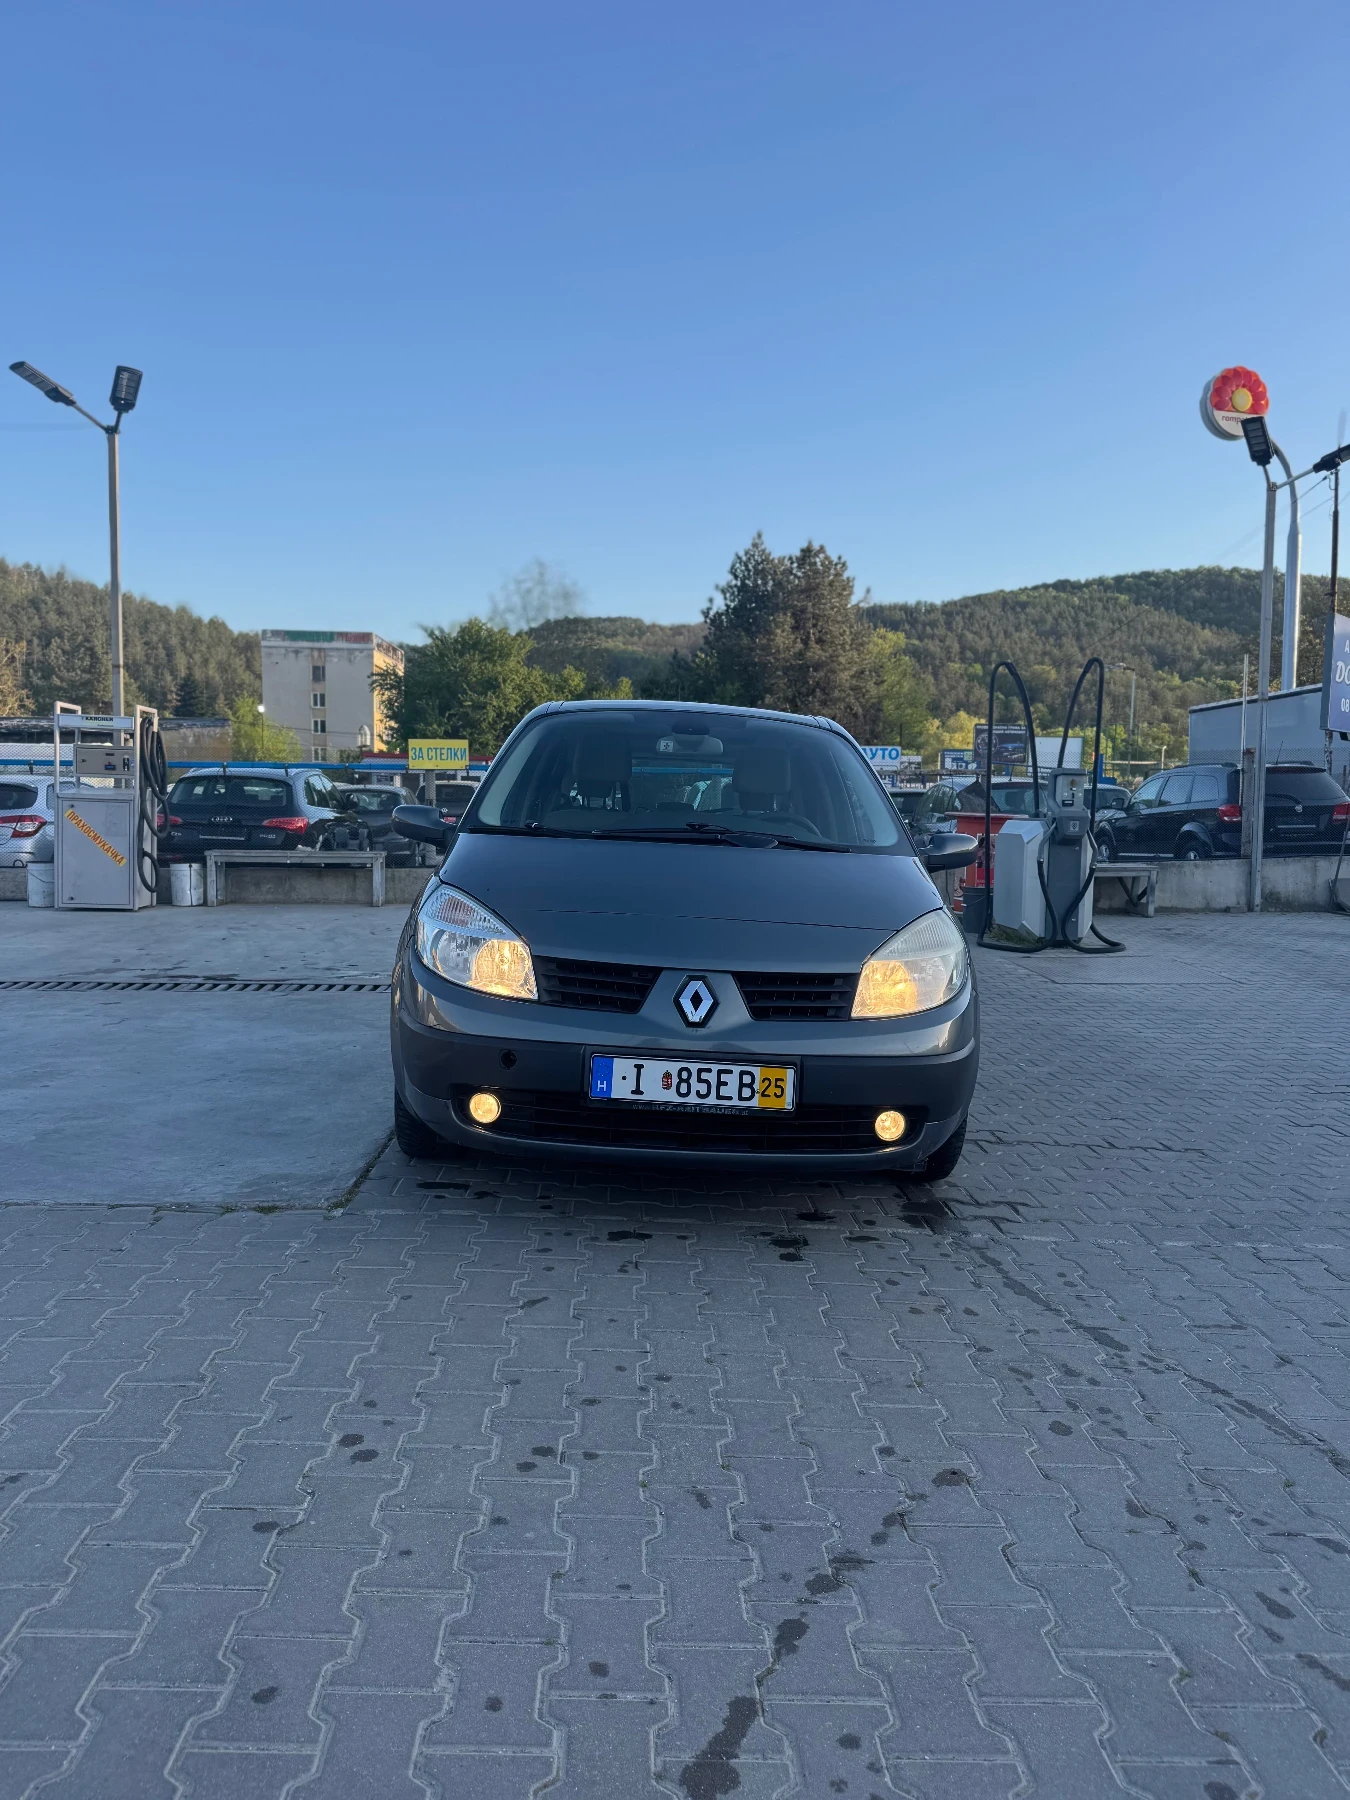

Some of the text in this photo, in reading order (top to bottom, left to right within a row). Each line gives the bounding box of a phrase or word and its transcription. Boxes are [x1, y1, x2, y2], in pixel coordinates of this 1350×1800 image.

[411, 746, 467, 762] ЗА СТЕЛКИ
[66, 810, 125, 865] ПРАХОСМУКАЧКА
[596, 1080, 607, 1092] H
[675, 1066, 756, 1102] 85EB
[760, 1077, 785, 1099] 25
